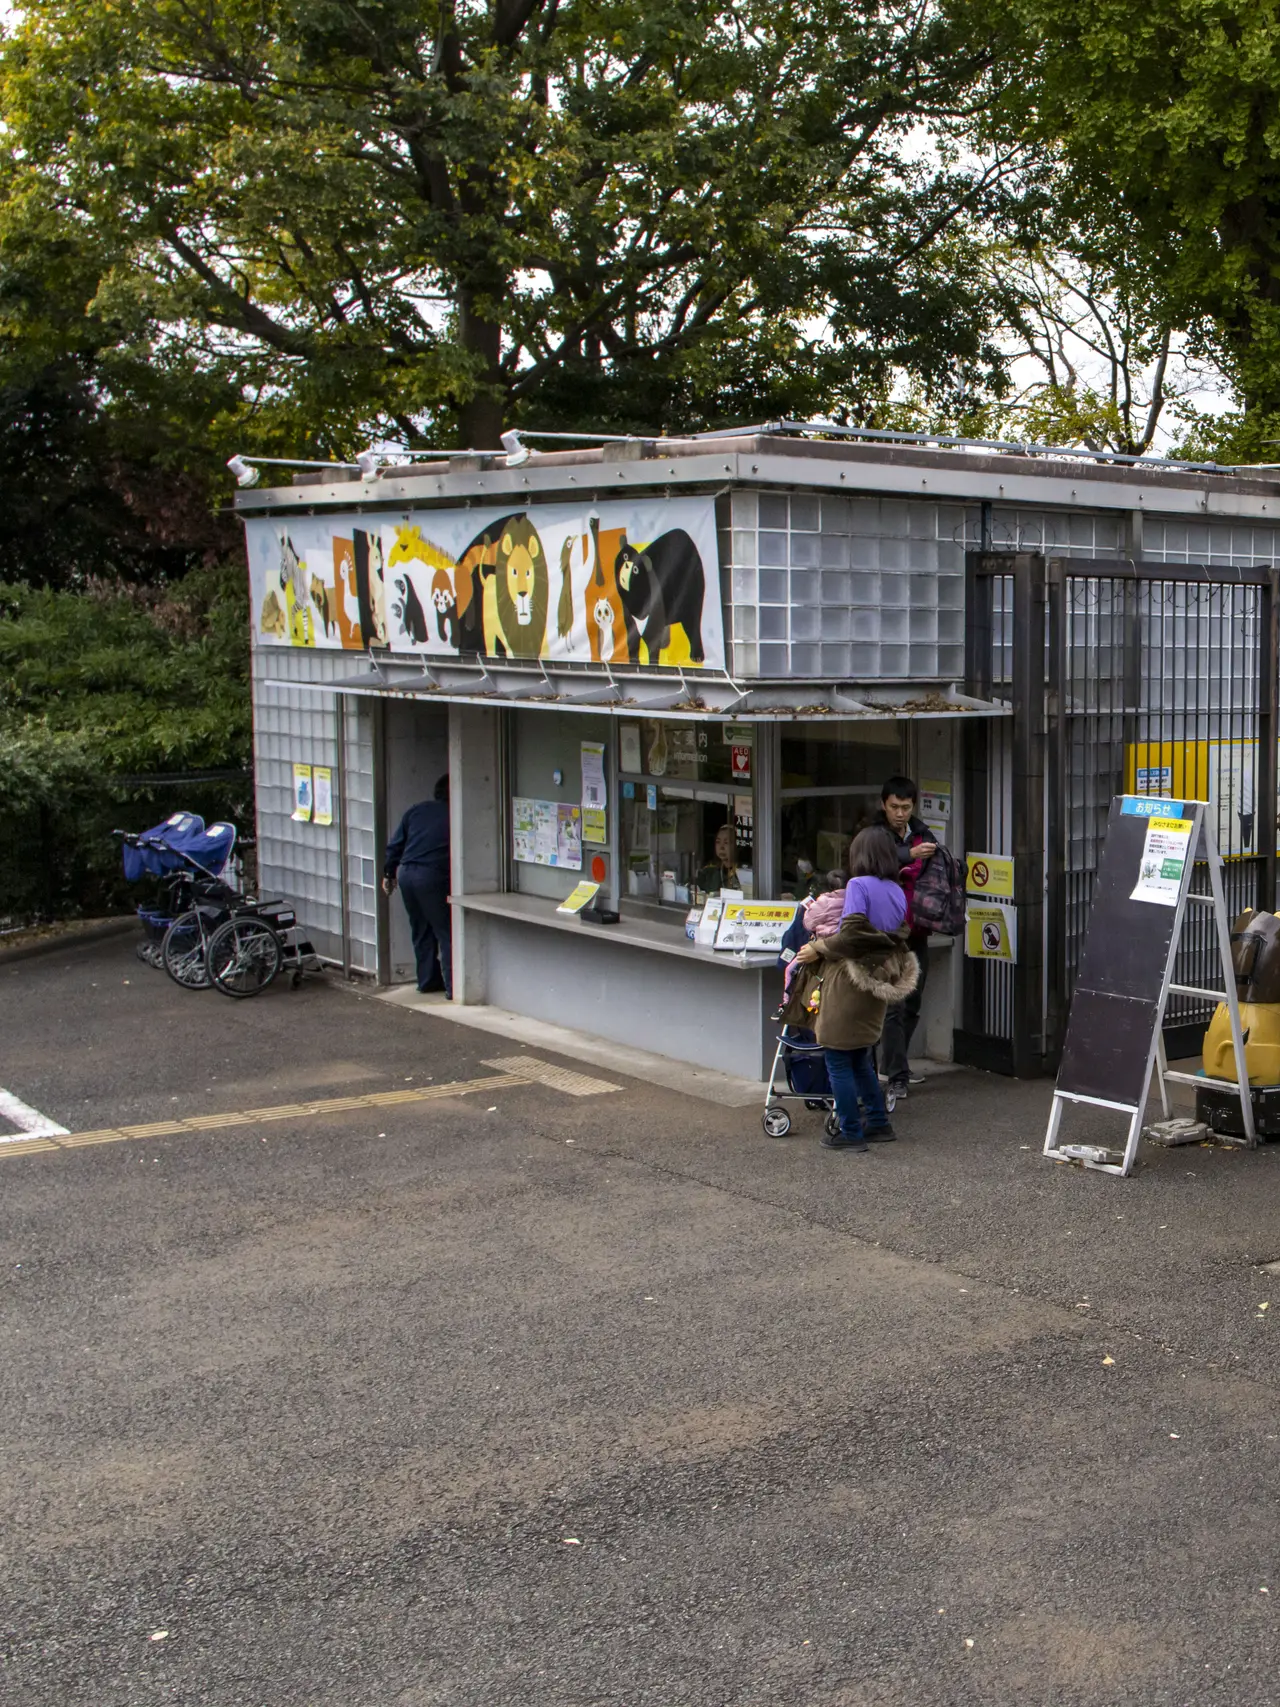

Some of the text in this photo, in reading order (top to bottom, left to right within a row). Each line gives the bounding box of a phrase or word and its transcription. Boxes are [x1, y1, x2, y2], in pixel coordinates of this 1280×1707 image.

[733, 747, 749, 755] AED
[1135, 802, 1172, 816] お知らせ
[730, 908, 790, 918] アコール消毒液
